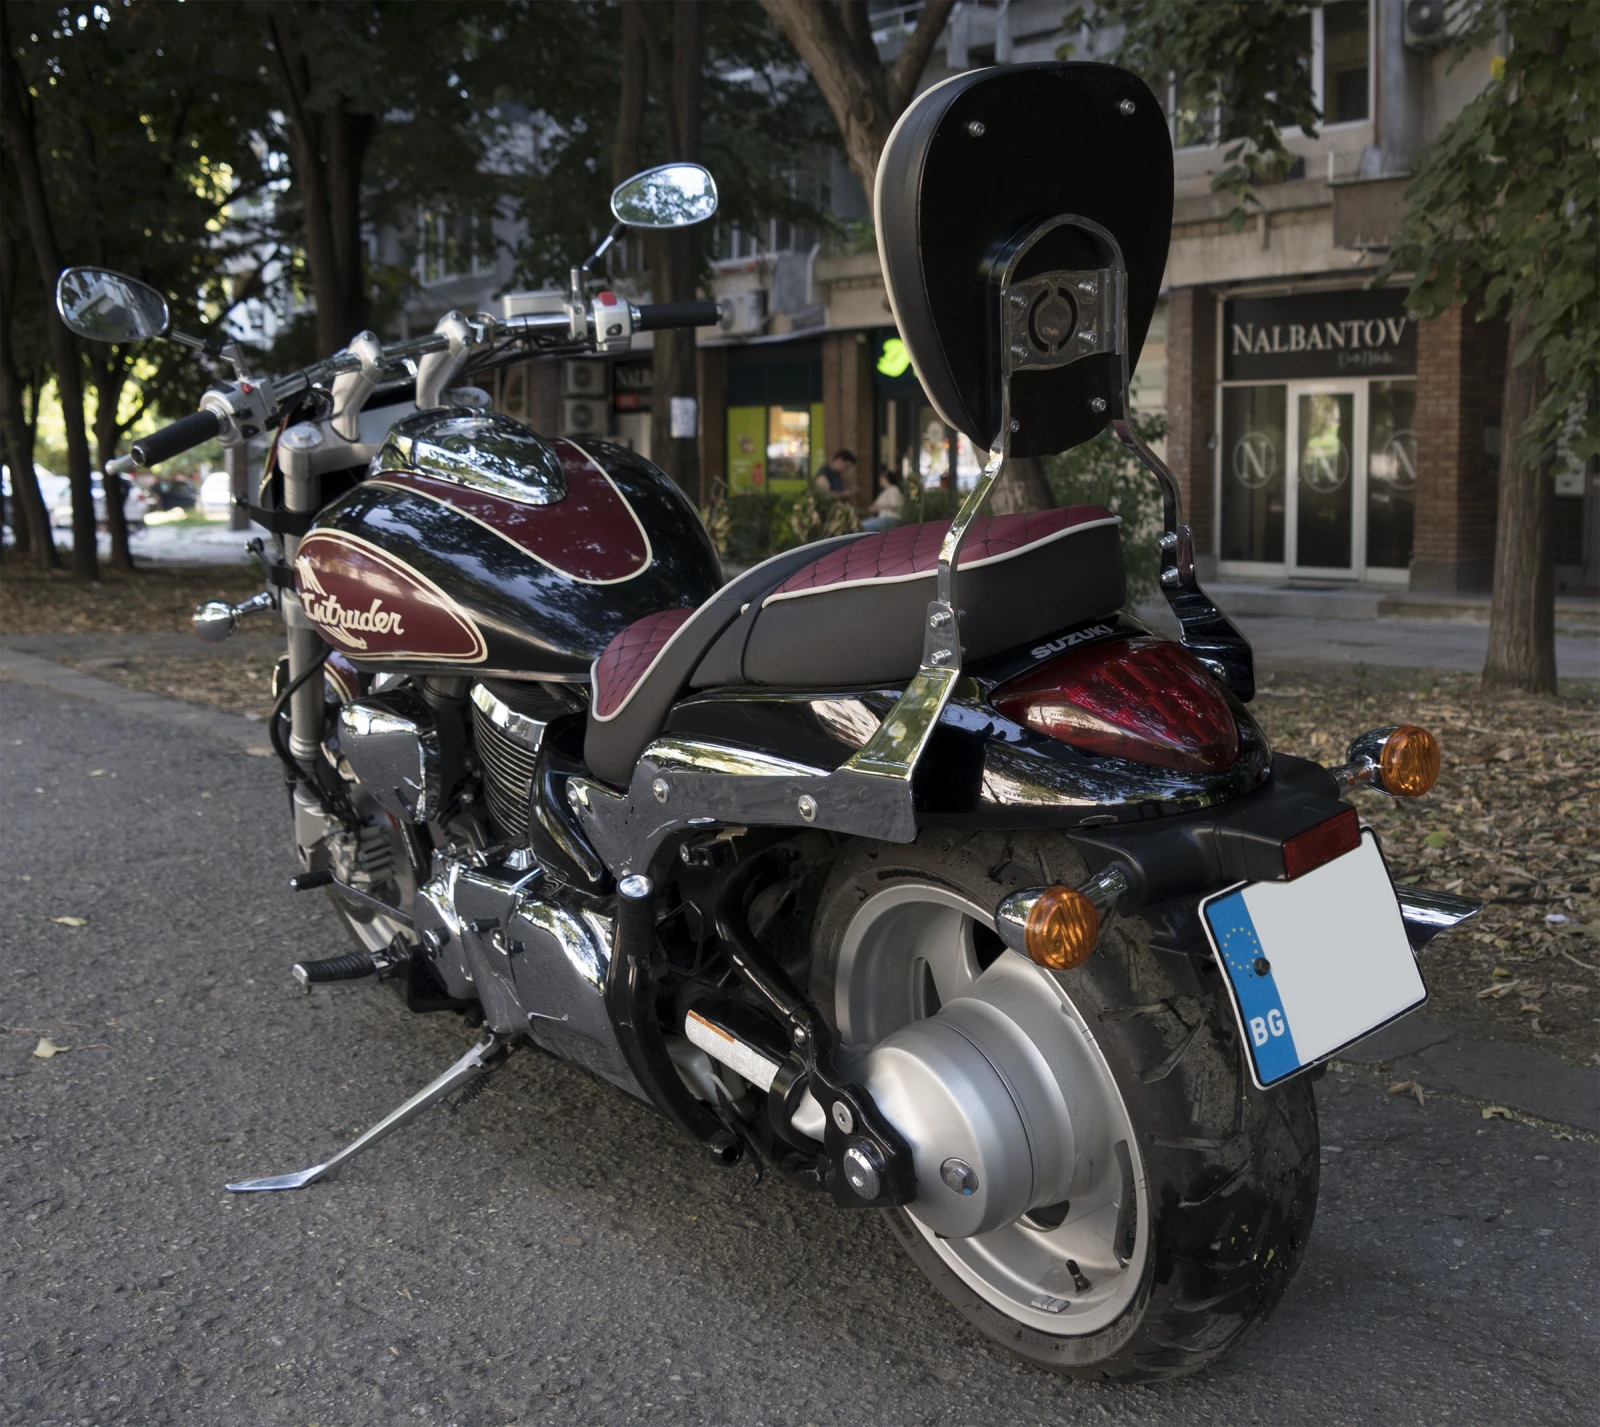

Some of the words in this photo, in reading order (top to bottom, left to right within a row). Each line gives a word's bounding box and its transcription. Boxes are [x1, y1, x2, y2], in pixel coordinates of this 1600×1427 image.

[1232, 317, 1406, 356] NALBANTOV
[300, 592, 405, 635] Intruder
[1030, 624, 1114, 659] SUZUKI
[1249, 1008, 1285, 1047] BG
